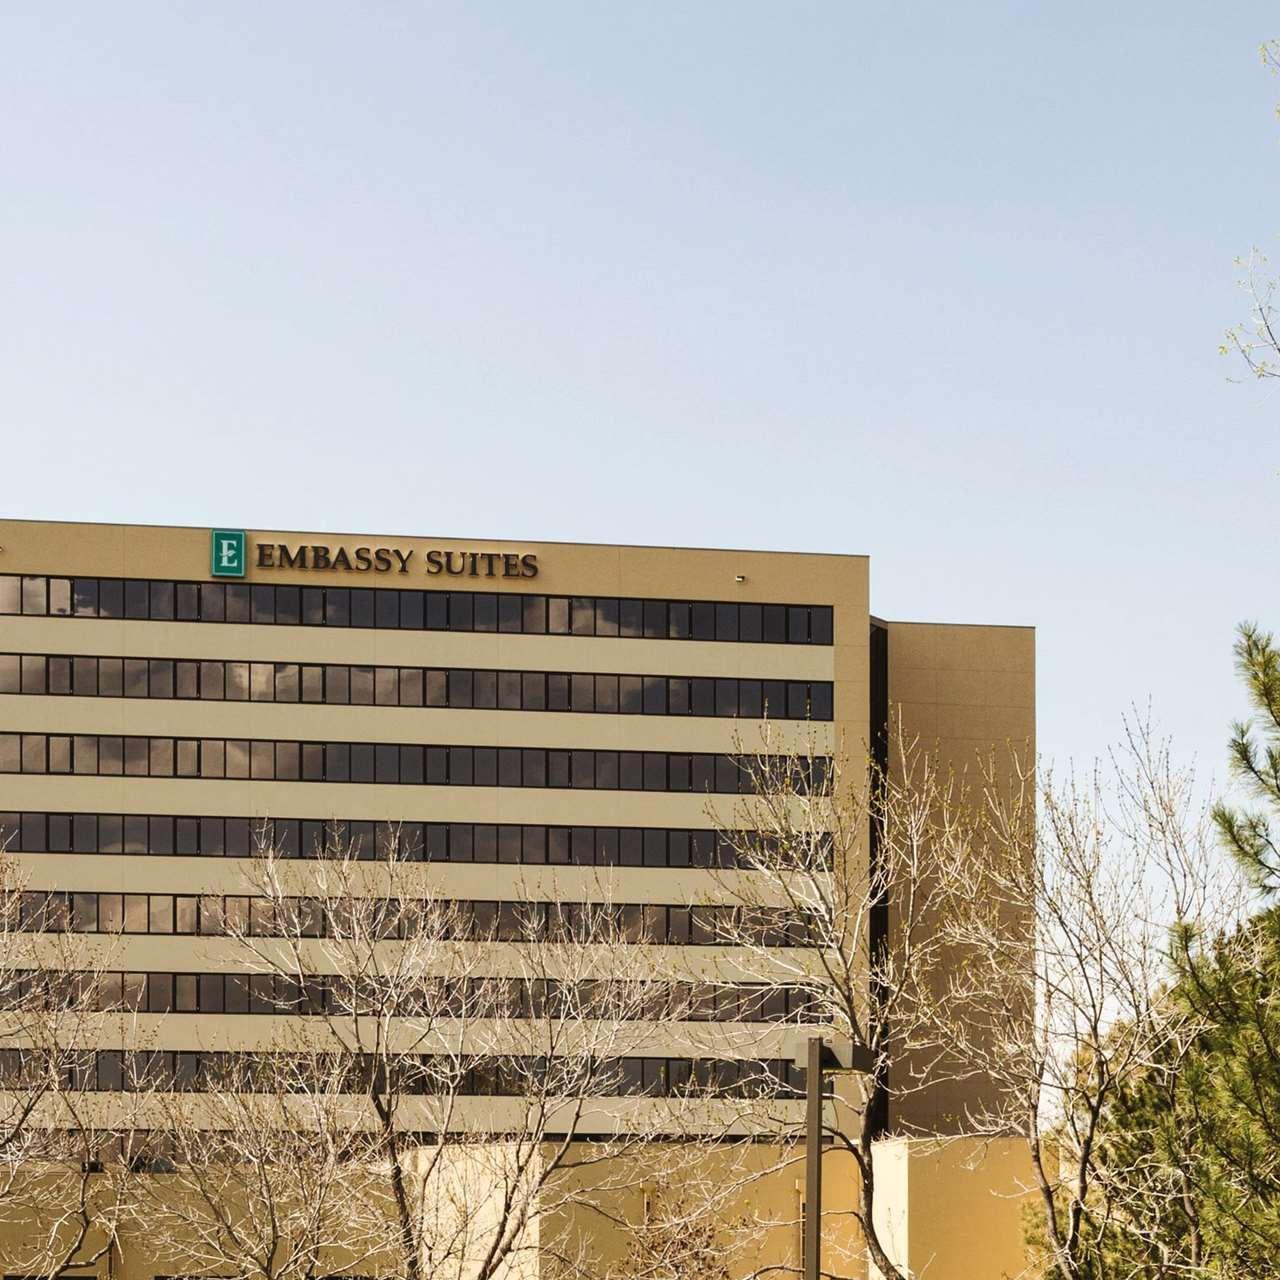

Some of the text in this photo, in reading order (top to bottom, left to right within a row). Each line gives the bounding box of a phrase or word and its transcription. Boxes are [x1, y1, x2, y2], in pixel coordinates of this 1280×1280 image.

[220, 540, 238, 567] E
[256, 543, 539, 578] EMBASSY SUITES
